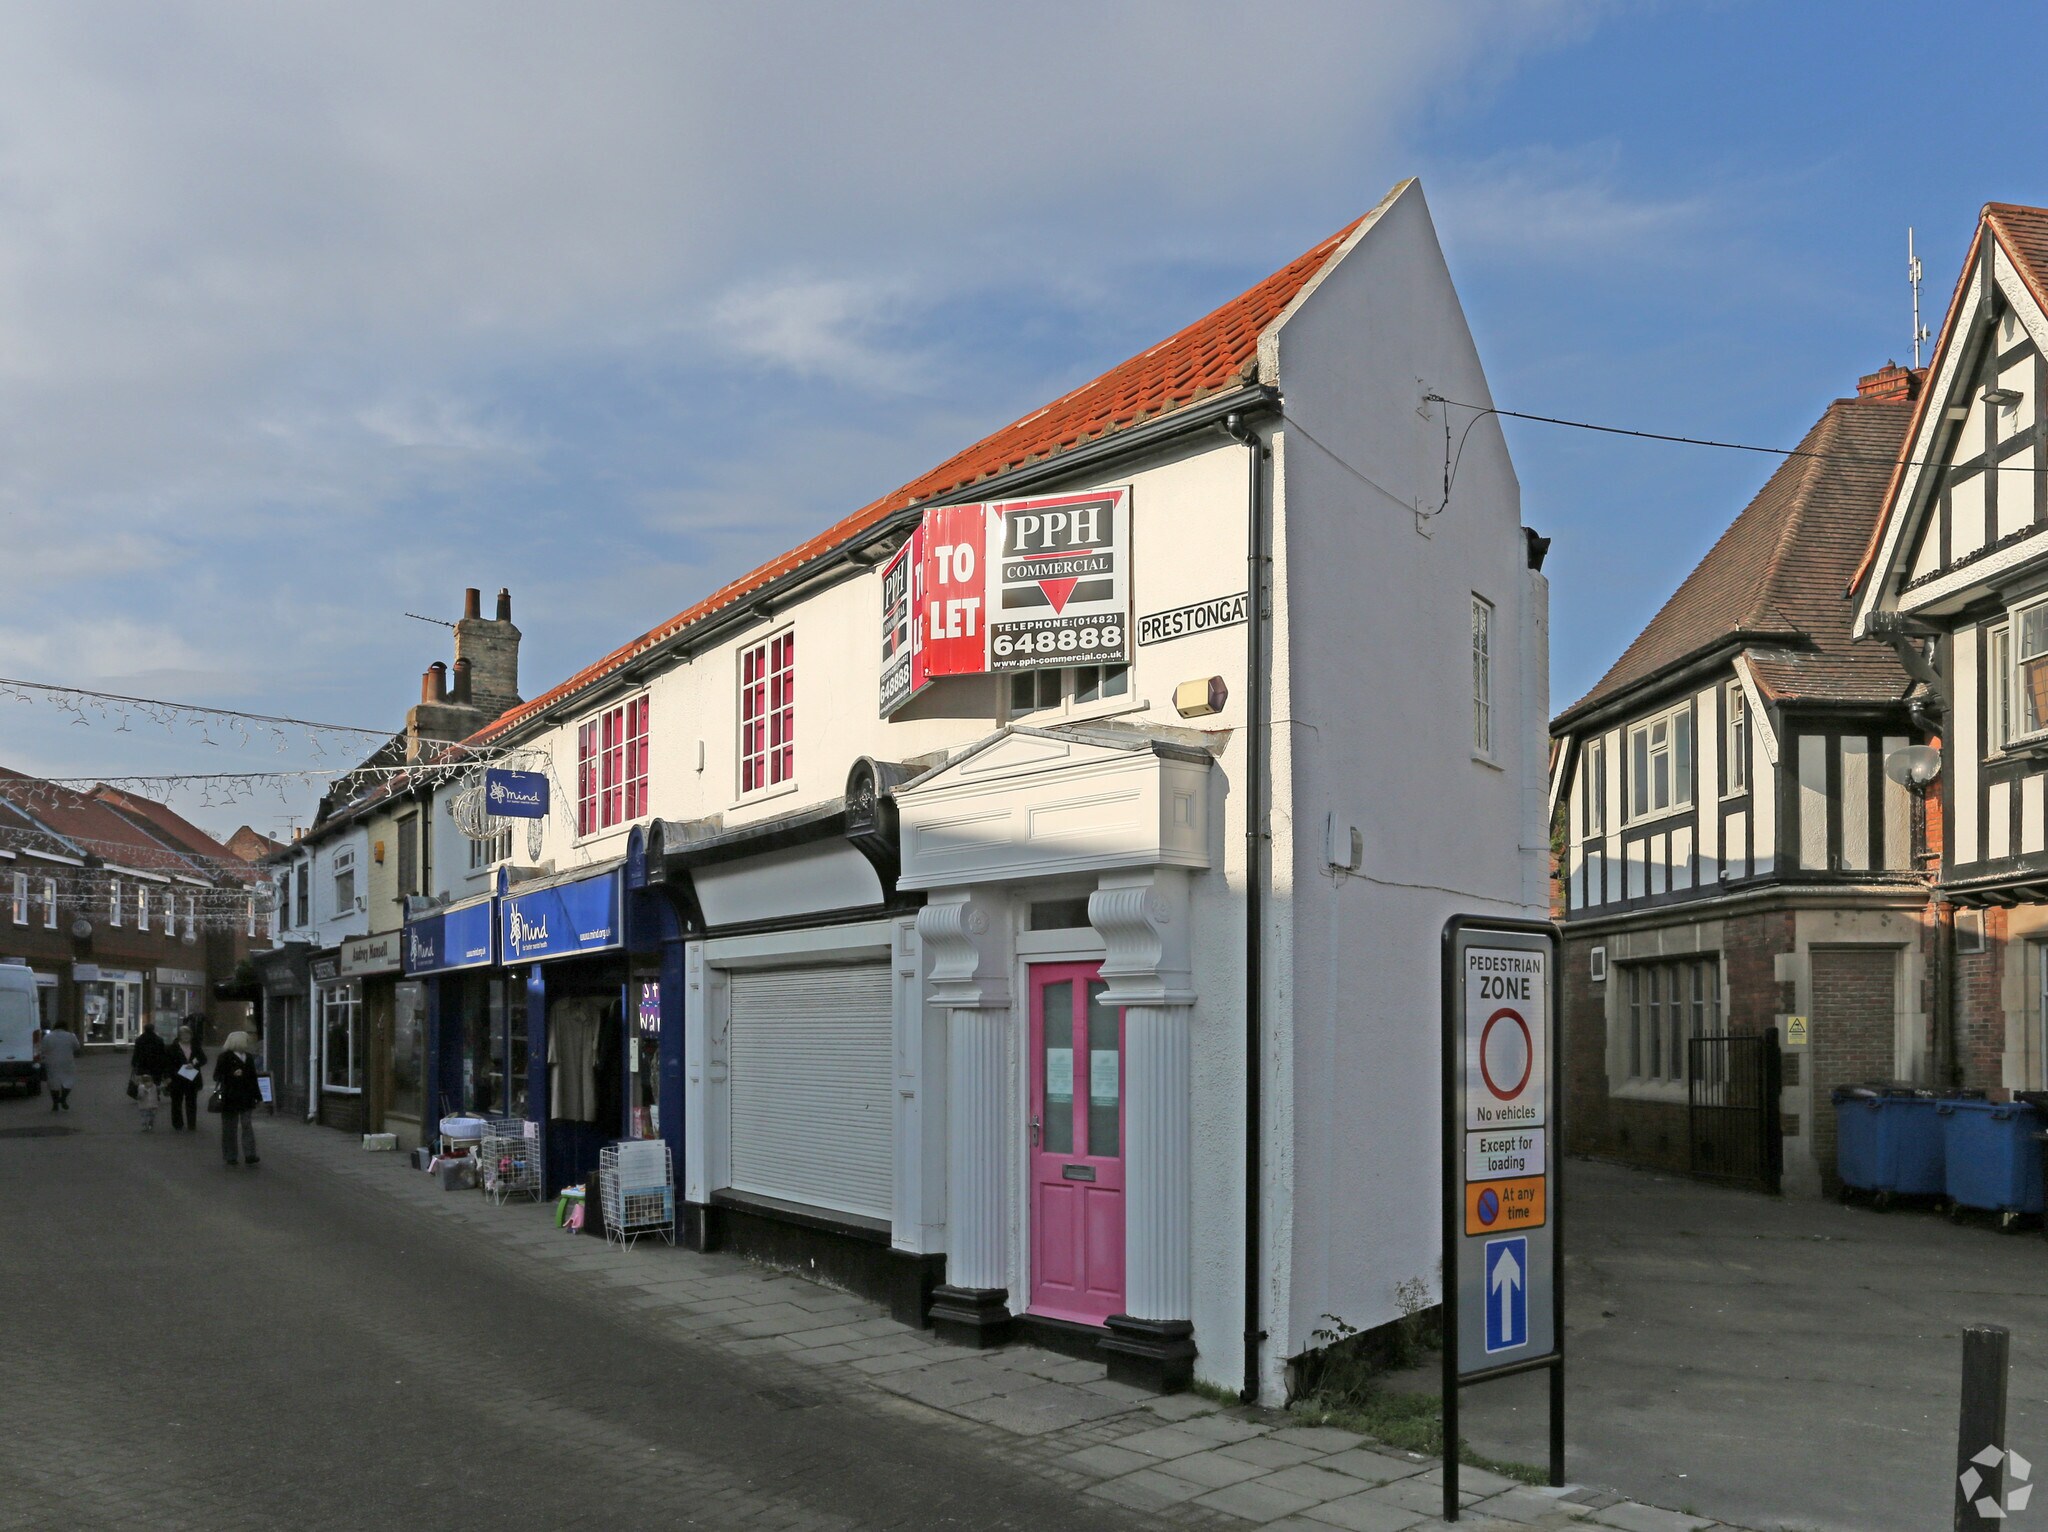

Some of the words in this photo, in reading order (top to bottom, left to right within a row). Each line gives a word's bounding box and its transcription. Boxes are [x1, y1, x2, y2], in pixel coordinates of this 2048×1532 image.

[1013, 507, 1101, 550] PPH
[935, 543, 975, 584] TO
[1007, 558, 1108, 579] COMMERCIAL
[885, 558, 905, 610] PPH
[915, 561, 924, 602] T
[930, 597, 980, 640] LET
[1142, 595, 1248, 642] PRESTONGAT
[913, 613, 923, 657] LE
[993, 625, 1122, 656] 648888
[993, 650, 1122, 668] www.pph-commercial.co.uk
[880, 663, 910, 704] 648888
[1470, 956, 1540, 973] PEDESTRIAN
[1480, 976, 1530, 1000] ZONE
[1477, 1107, 1492, 1121] No
[1496, 1105, 1536, 1120] vehicles
[1480, 1137, 1516, 1153] Except
[1519, 1136, 1533, 1149] for
[1488, 1156, 1525, 1171] loading
[1503, 1188, 1514, 1202] At
[1518, 1189, 1535, 1202] any
[1508, 1206, 1530, 1220] time
